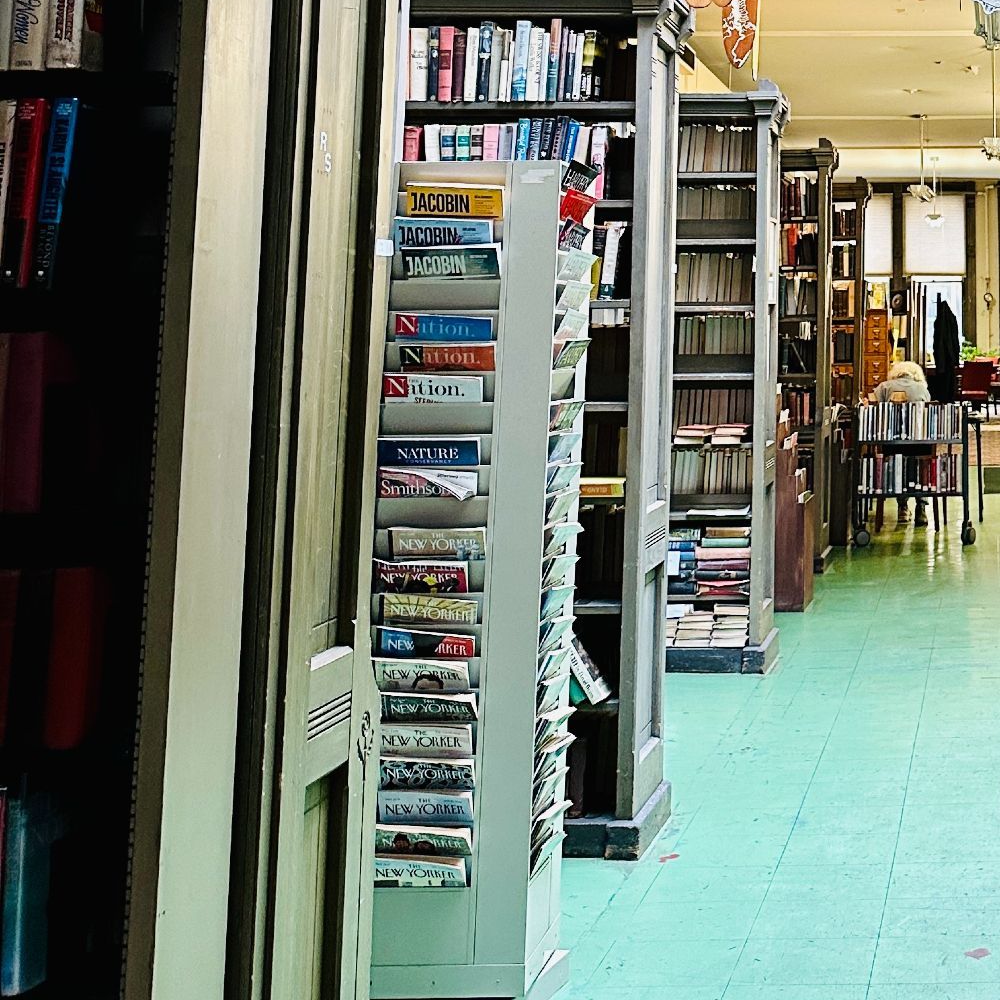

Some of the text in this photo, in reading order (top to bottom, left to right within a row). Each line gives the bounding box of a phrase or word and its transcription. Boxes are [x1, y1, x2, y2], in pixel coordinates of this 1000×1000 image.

[64, 0, 75, 42] FAMILY
[319, 131, 332, 173] R S
[411, 192, 470, 213] JACOBIN
[398, 226, 458, 246] JACOBIN
[406, 254, 467, 276] JACOBIN
[405, 348, 481, 364] Nation.
[386, 377, 465, 397] Nation.
[397, 448, 459, 460] NATURE
[399, 538, 476, 550] NEW YORKER
[390, 604, 470, 621] NEW YORKER
[388, 640, 467, 656] NEW RKER
[382, 670, 462, 680] NEW YORKER
[390, 703, 471, 714] NEW YORKER
[382, 735, 462, 748] NEW YORKER
[386, 768, 467, 780] NEW YORKER
[385, 804, 466, 815] NEW YORKER
[375, 868, 455, 879] NEW YORKER
